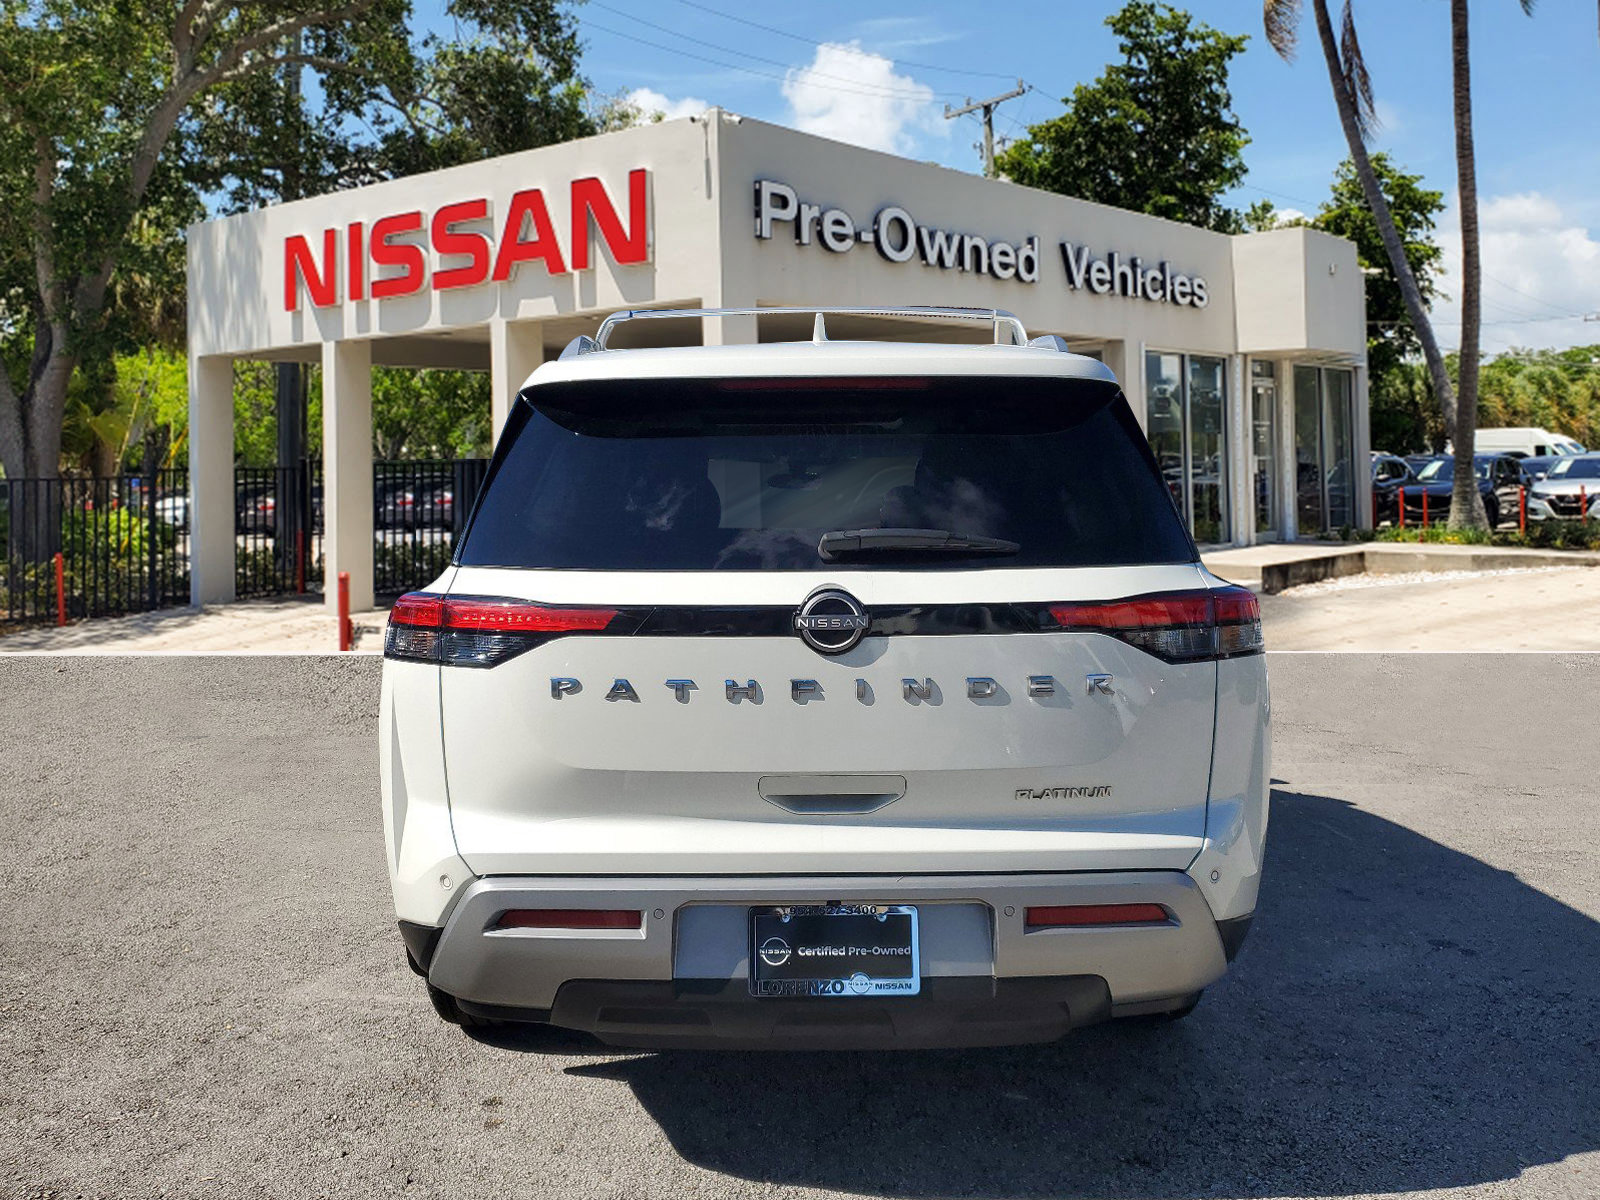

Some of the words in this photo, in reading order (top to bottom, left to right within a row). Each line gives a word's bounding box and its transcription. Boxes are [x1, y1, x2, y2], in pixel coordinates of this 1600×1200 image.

[285, 169, 648, 312] NISSAN
[755, 180, 1040, 283] Pre-Owned
[1061, 242, 1208, 308] Vehicles
[797, 617, 868, 629] NISSAN
[550, 673, 1117, 704] PATHFINDER
[1015, 786, 1112, 800] PLATINUM
[797, 946, 845, 957] Certified
[848, 946, 911, 957] Pre-Owned
[758, 980, 845, 995] LORENZO
